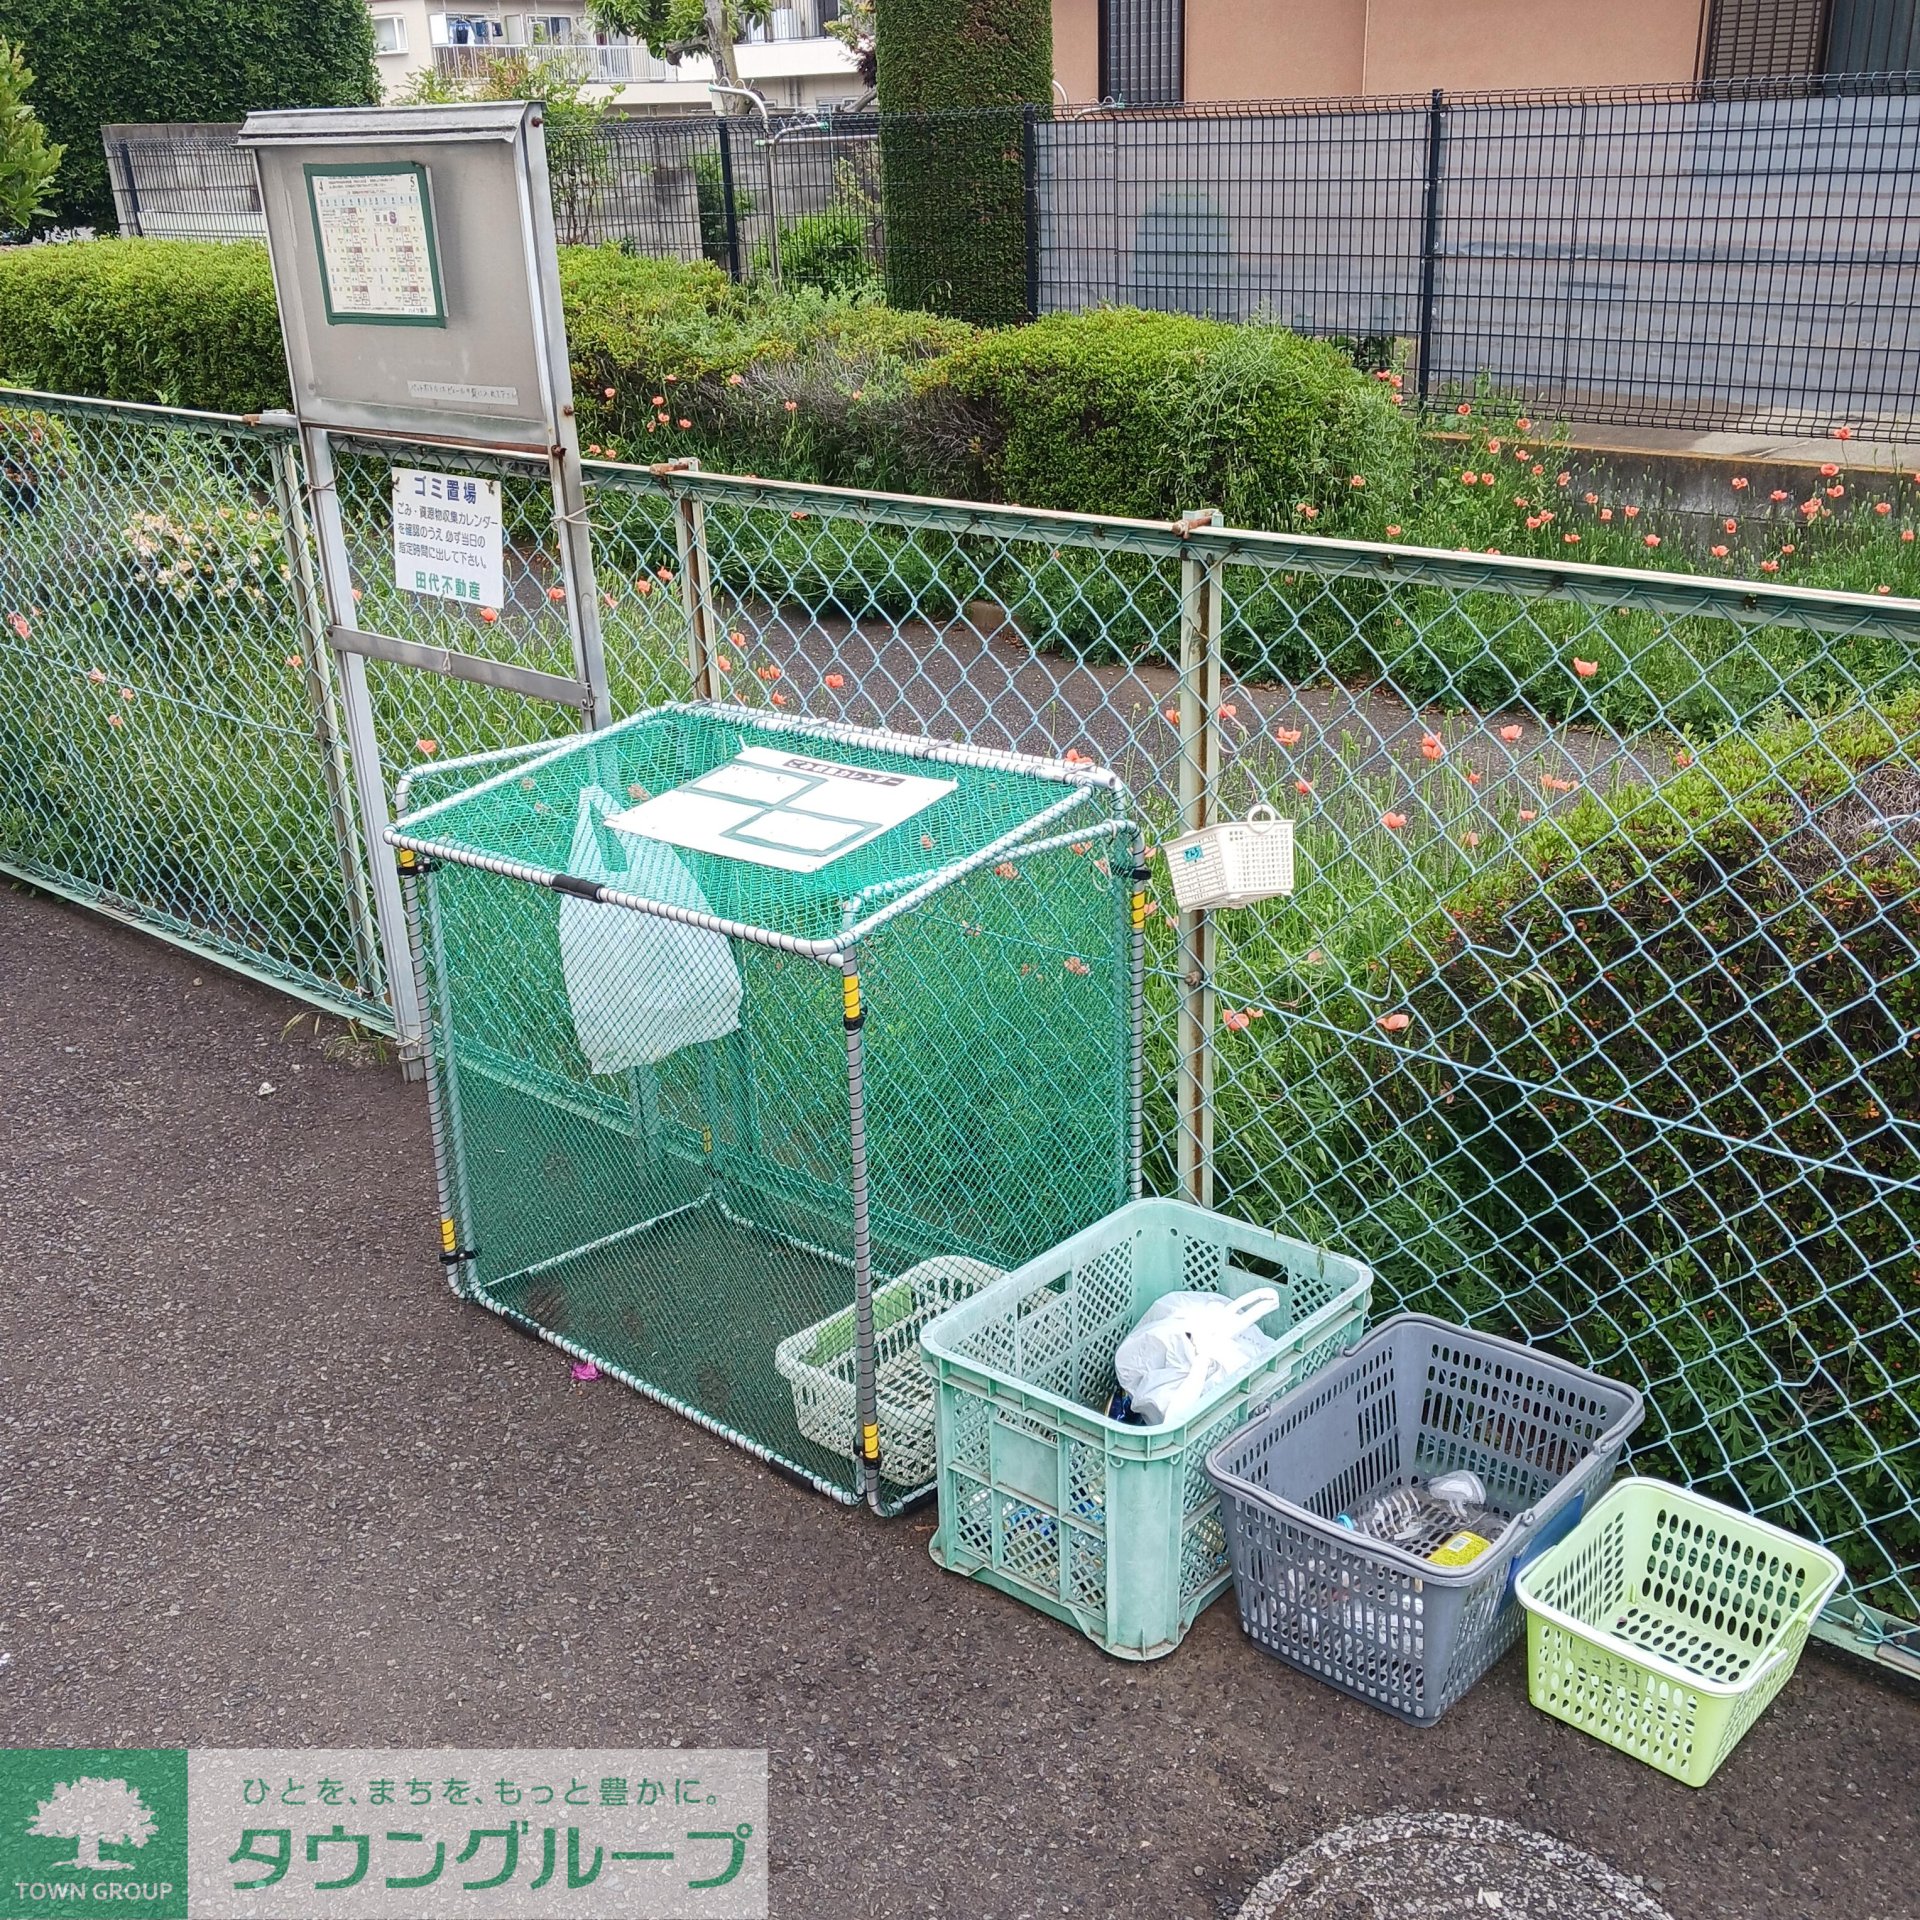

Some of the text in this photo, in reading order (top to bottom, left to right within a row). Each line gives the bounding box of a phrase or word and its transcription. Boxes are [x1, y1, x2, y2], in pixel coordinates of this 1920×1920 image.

[414, 475, 477, 505] ゴミ置場
[397, 502, 499, 529] ごみ・資源物収集カレンダー
[398, 541, 488, 570] 指定時間に出して下さい。
[415, 570, 481, 601] 田代不動産
